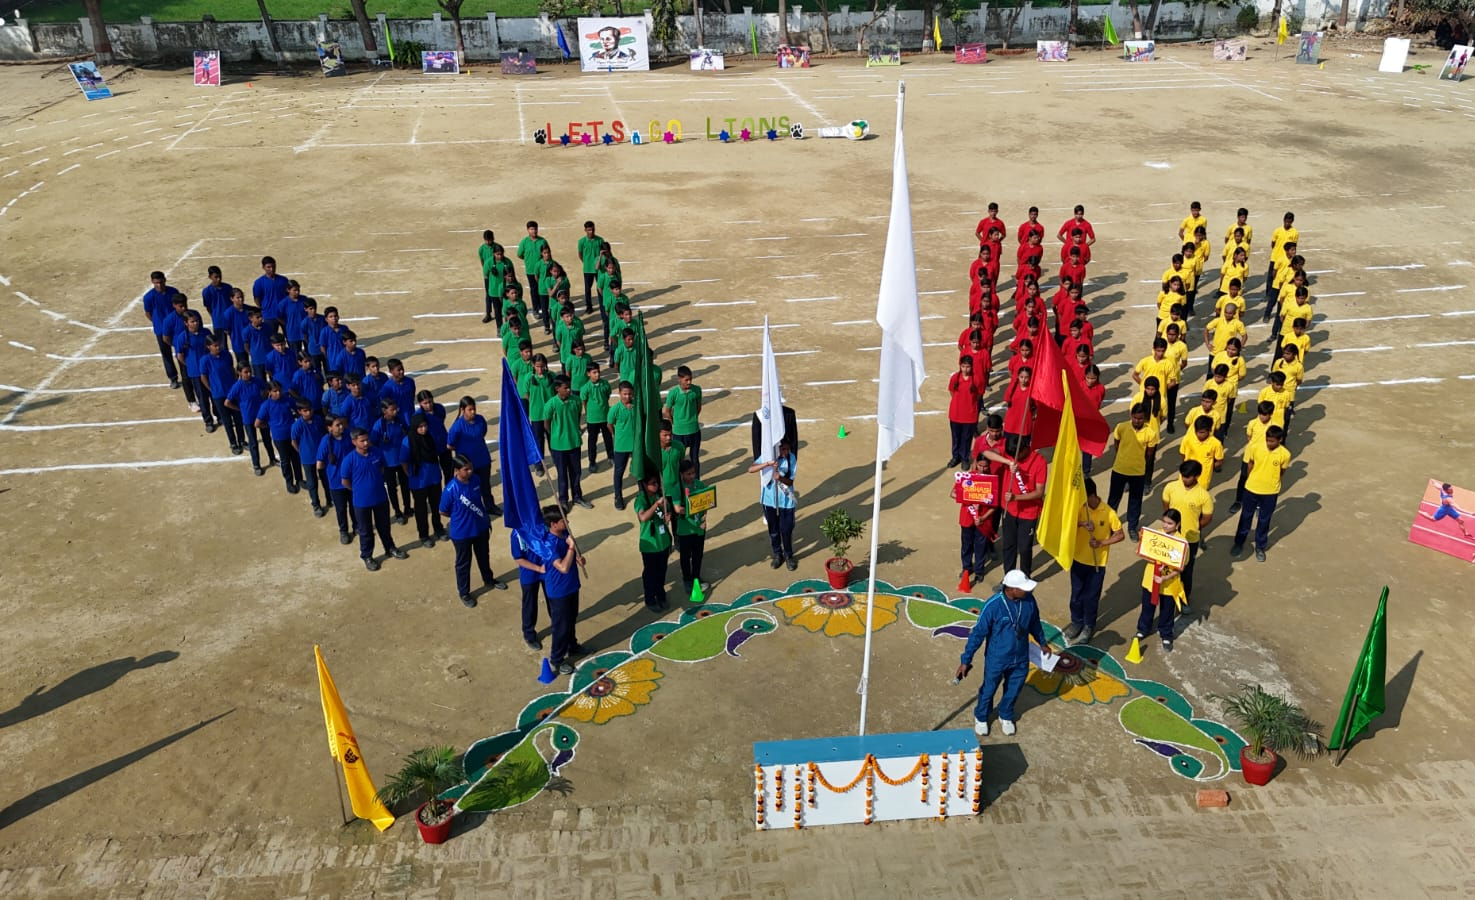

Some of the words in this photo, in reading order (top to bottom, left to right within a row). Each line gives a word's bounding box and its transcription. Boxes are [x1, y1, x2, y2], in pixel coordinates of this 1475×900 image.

[546, 120, 625, 145] LETS
[649, 119, 682, 142] GO
[706, 115, 791, 140] LIONS
